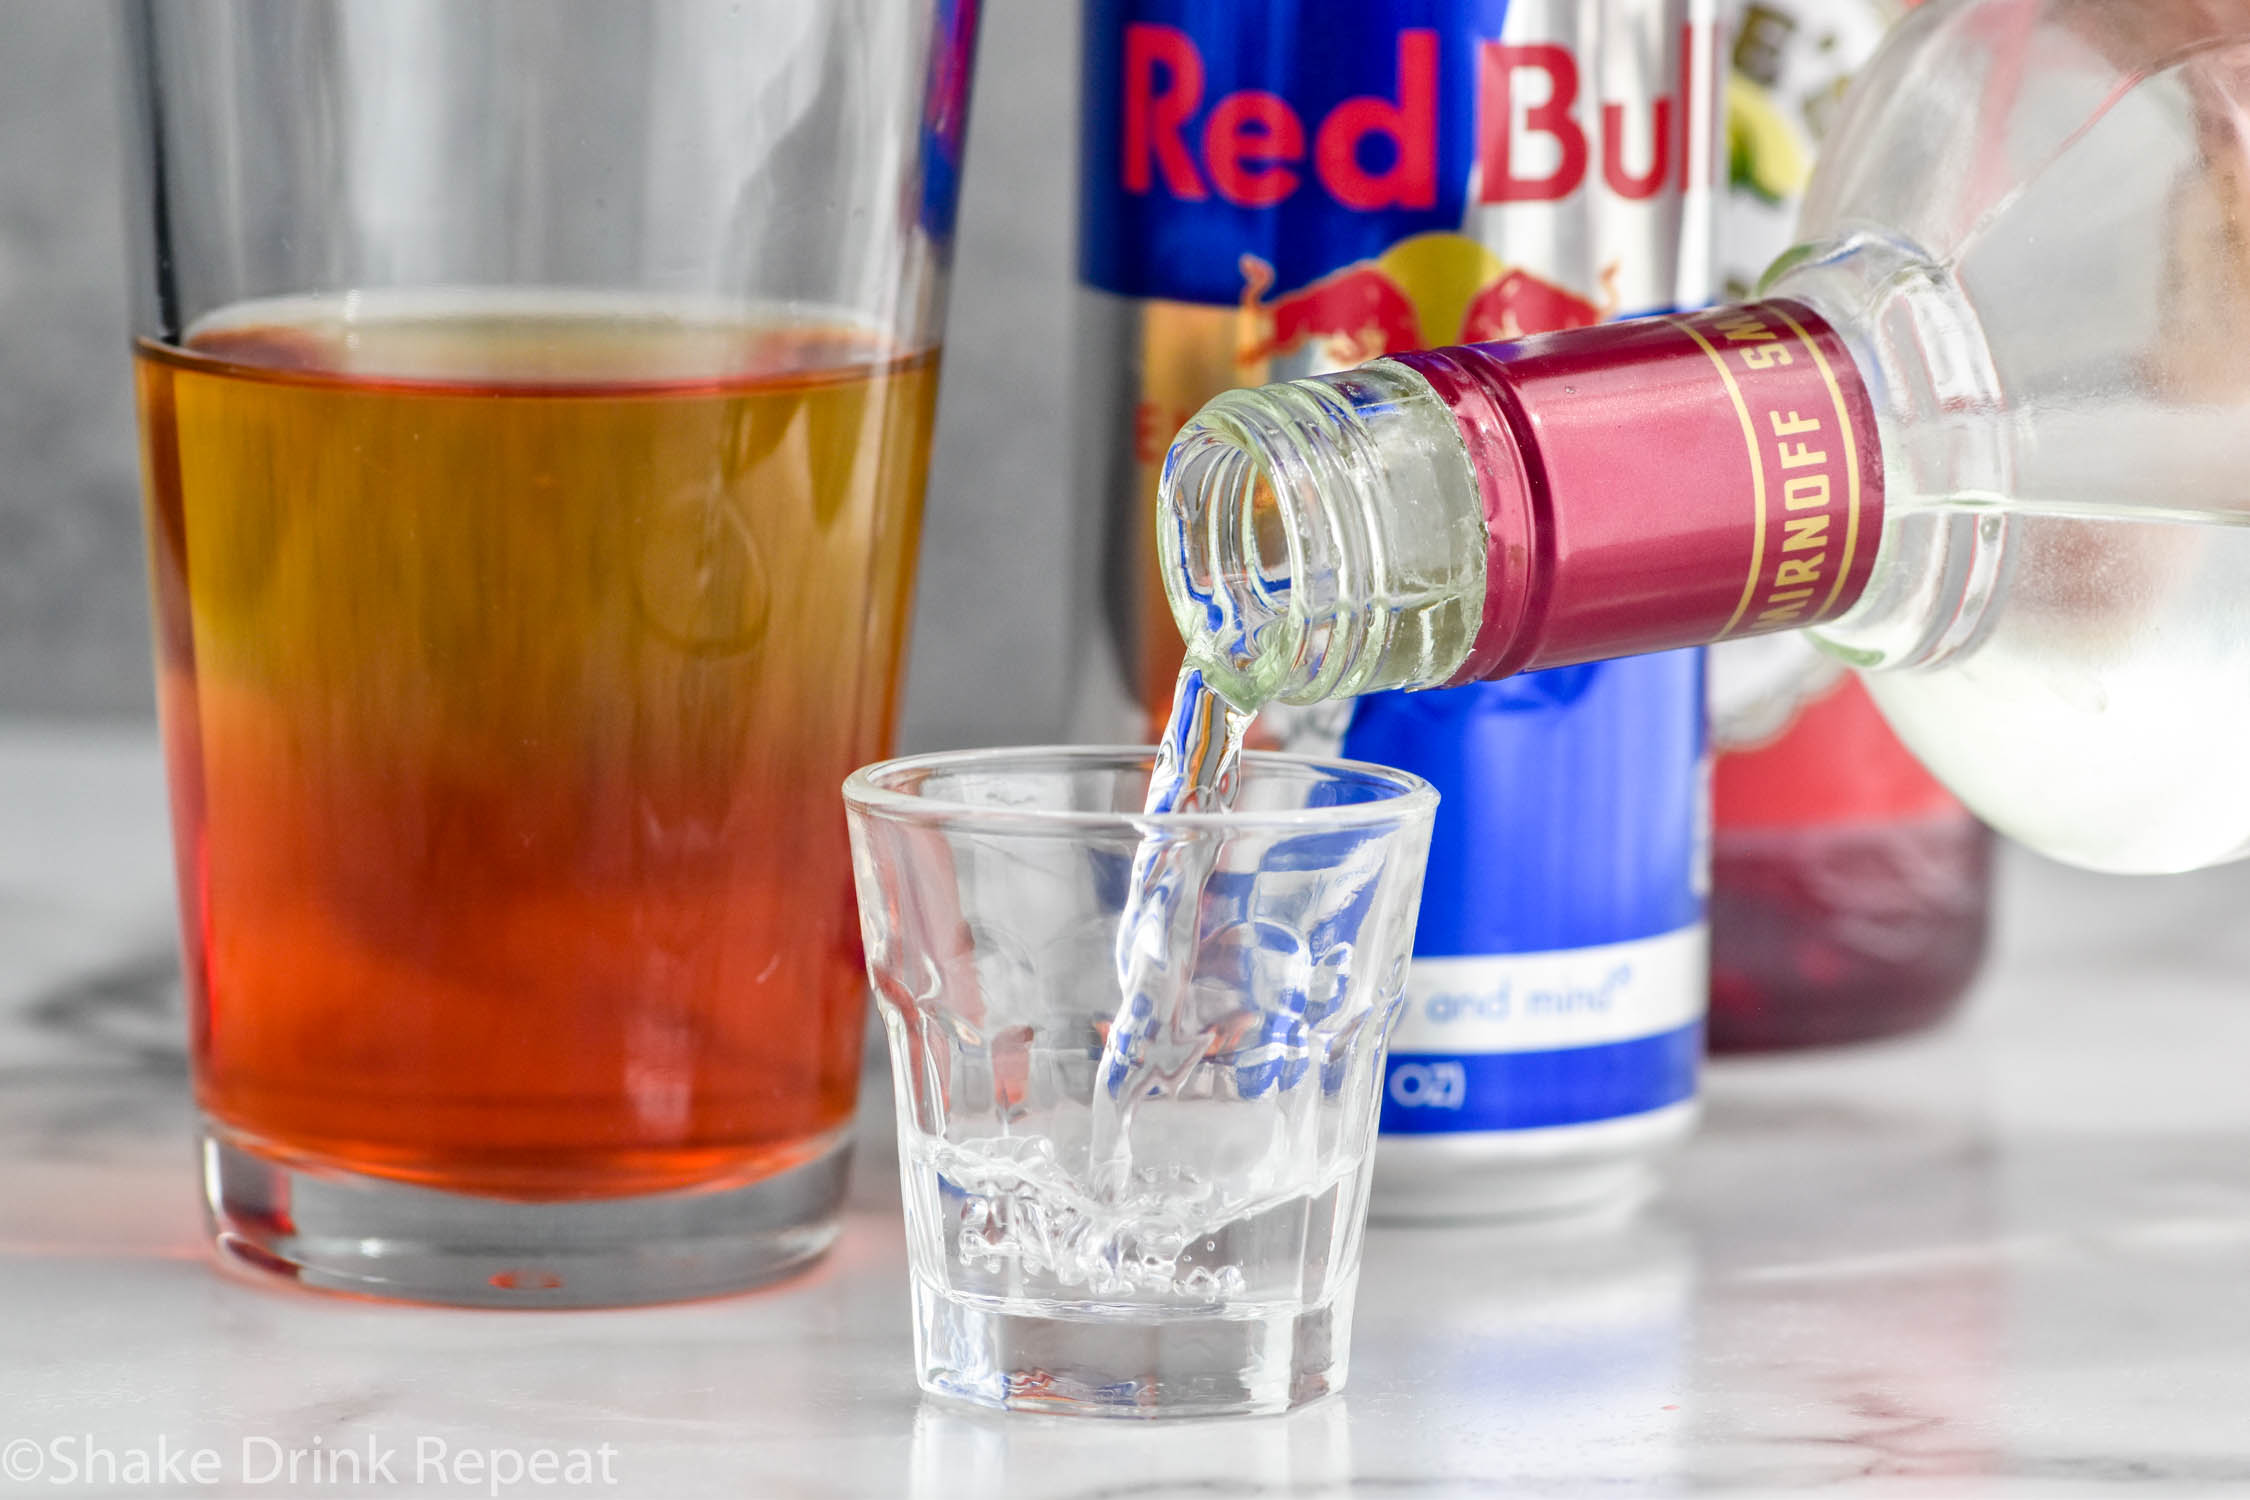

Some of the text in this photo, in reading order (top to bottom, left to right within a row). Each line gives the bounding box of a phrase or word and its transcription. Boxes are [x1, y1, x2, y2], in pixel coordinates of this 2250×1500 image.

[1122, 23, 1439, 211] Red
[1476, 23, 1695, 206] Bul
[1425, 976, 1513, 1024] and
